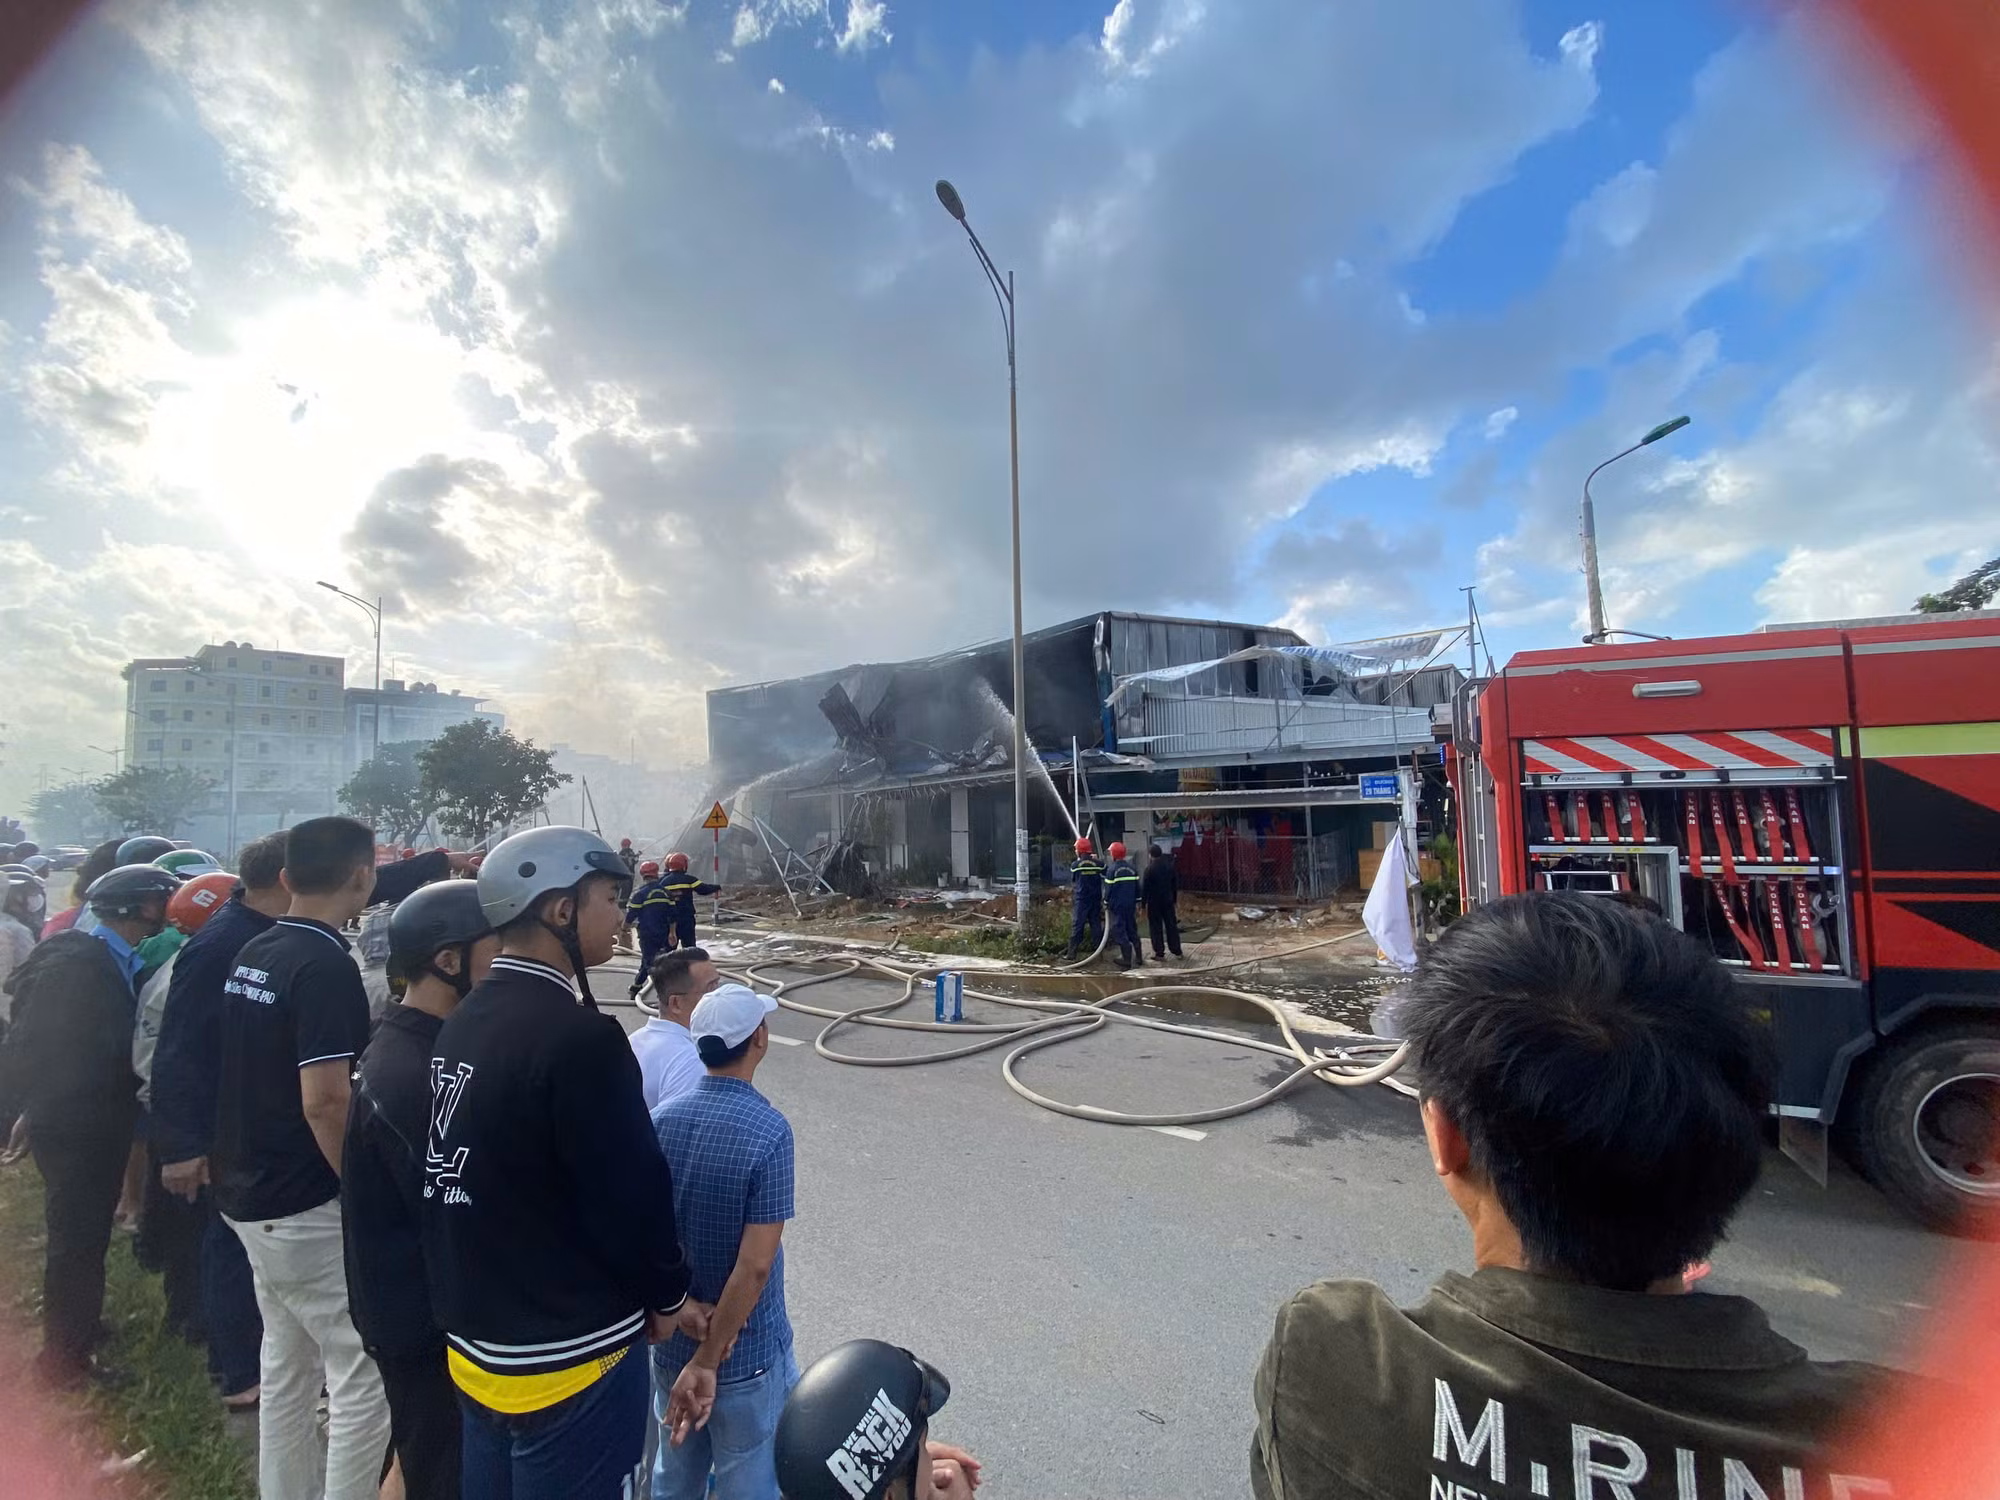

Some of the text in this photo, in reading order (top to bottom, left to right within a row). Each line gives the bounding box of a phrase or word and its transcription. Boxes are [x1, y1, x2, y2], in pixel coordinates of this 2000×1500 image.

[1714, 882, 1735, 924] VOLKAN
[1769, 885, 1782, 929] VOLKAN
[1797, 885, 1810, 929] VOLKAN
[825, 1387, 906, 1500] ROCK
[842, 1408, 876, 1450] WE WILL
[882, 1417, 912, 1461] YOU
